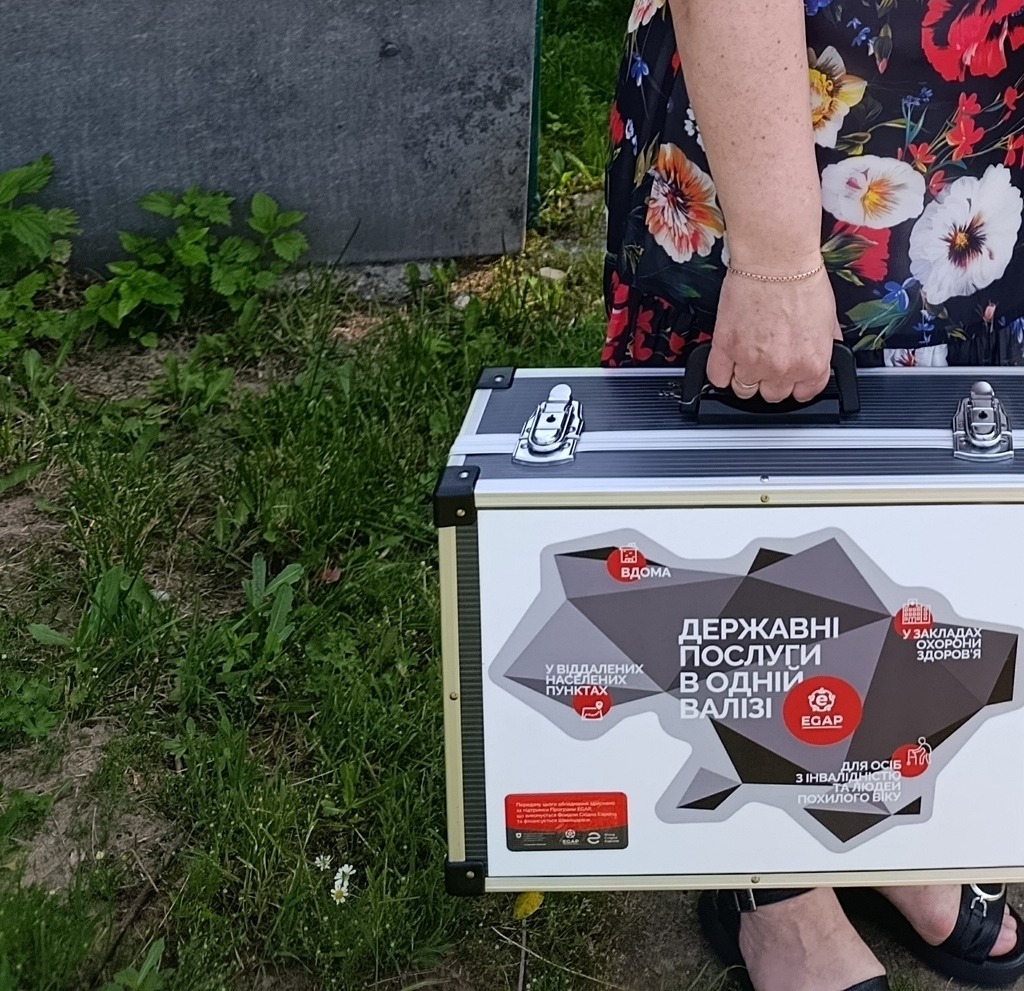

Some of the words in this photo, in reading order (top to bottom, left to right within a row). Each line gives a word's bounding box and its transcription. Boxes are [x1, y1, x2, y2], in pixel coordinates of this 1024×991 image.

[621, 566, 671, 580] ВДОМА
[678, 616, 840, 645] ДЕРЖАВНІ
[902, 629, 911, 640] У
[913, 627, 983, 641] ЗАКЛАДАХ
[916, 638, 982, 649] ОХОРОНИ
[680, 644, 822, 667] ПОСЛУГИ
[916, 649, 982, 663] ЗДОРОВ'Я
[545, 664, 554, 674] У
[556, 664, 644, 677] ВІДДАЛЕНИХ
[545, 675, 627, 685] НАСЕЛЕНИХ
[680, 672, 699, 693] В
[706, 665, 804, 698] ОДНІЙ
[546, 686, 608, 696] ПУНКТАХ
[680, 697, 773, 719] ВАЛІЗІ
[801, 715, 843, 726] EGAP
[841, 760, 868, 772] ДЛЯ
[870, 760, 902, 770] ОСІБ
[806, 771, 902, 784] ІНВАЛІДНІСТЮ
[833, 783, 850, 793] ТА
[797, 793, 870, 804] ПОХИЛОГО
[872, 791, 902, 802] ВІКУ
